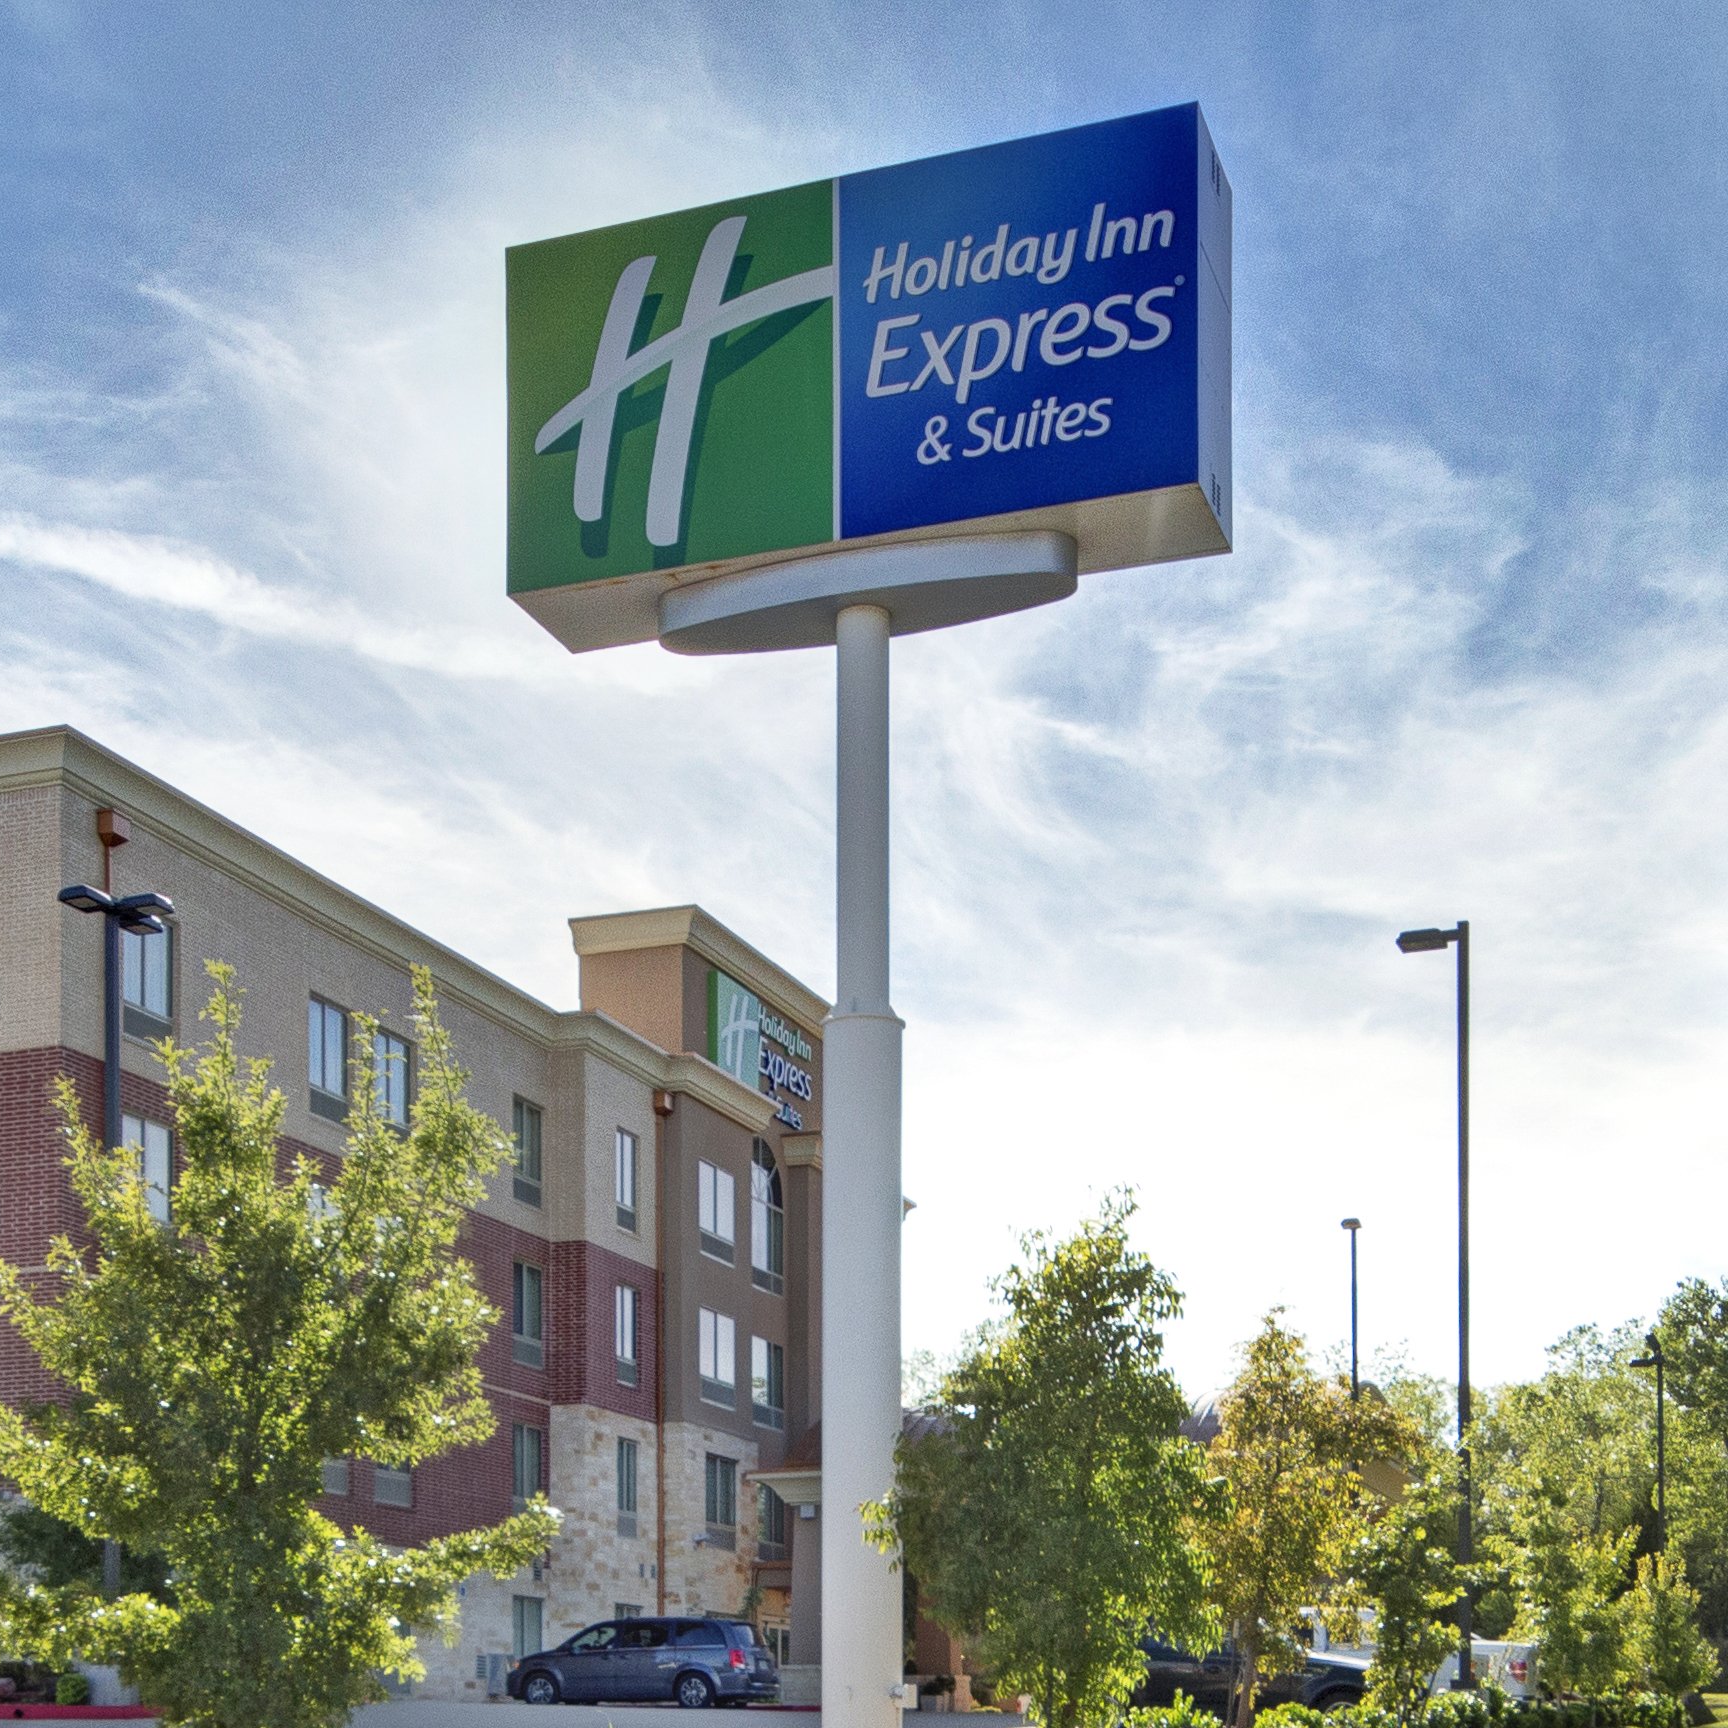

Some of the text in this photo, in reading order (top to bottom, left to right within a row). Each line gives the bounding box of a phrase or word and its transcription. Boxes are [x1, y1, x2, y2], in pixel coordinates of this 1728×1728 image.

[862, 202, 1176, 304] Holiday Inn
[865, 286, 1176, 404] Express
[916, 396, 1114, 465] & Suites
[758, 1003, 812, 1063] Holiday Inn
[759, 1035, 812, 1101] Express
